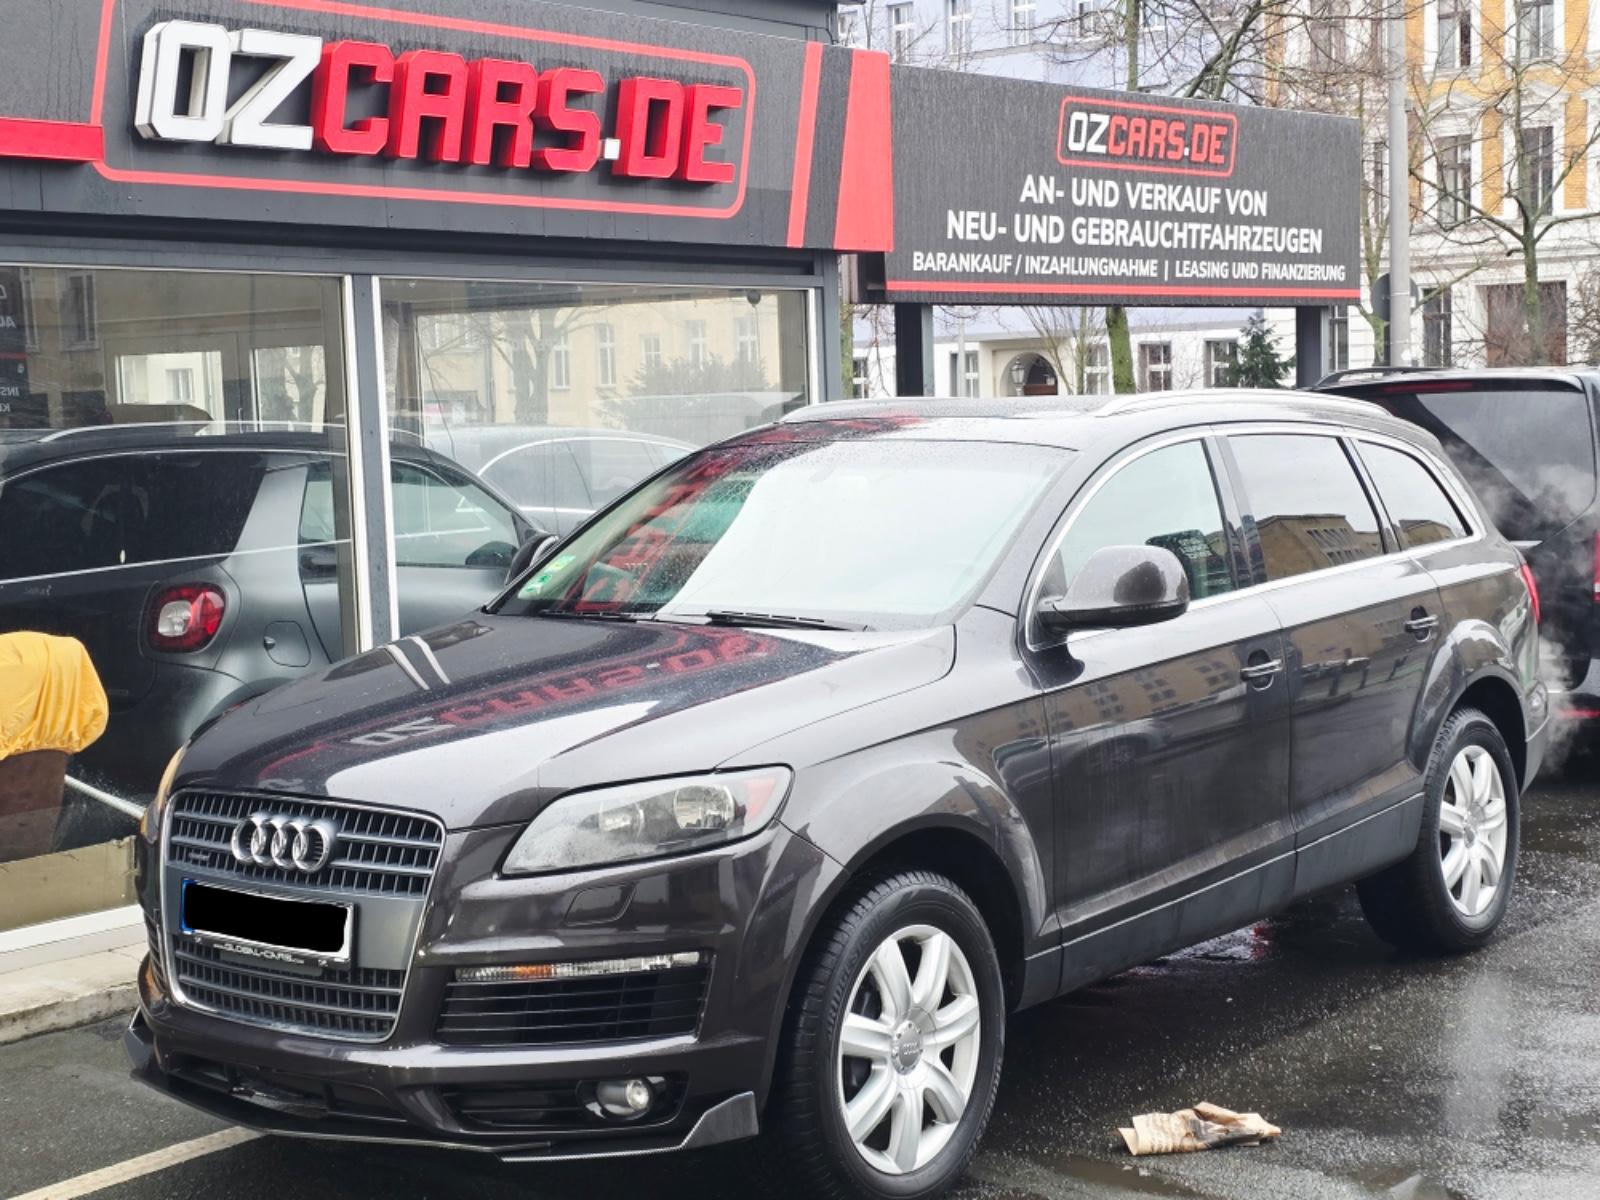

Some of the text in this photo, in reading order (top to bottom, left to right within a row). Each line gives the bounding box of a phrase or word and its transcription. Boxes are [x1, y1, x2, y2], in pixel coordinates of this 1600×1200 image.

[134, 19, 743, 184] OZCARS.DE
[1068, 111, 1228, 164] OZCARS.DE
[1019, 174, 1268, 217] AN- UND VERKAUF VON
[946, 209, 1323, 254] NEU- UND GEBRAUCHTFAHRZEUGEN
[912, 250, 1012, 273] BARANKAUF
[1025, 255, 1158, 278] INZAHLUNGNAHME
[1175, 260, 1229, 279] LEASING
[1232, 263, 1258, 279] UND
[1261, 262, 1346, 282] FINANZIERUNG
